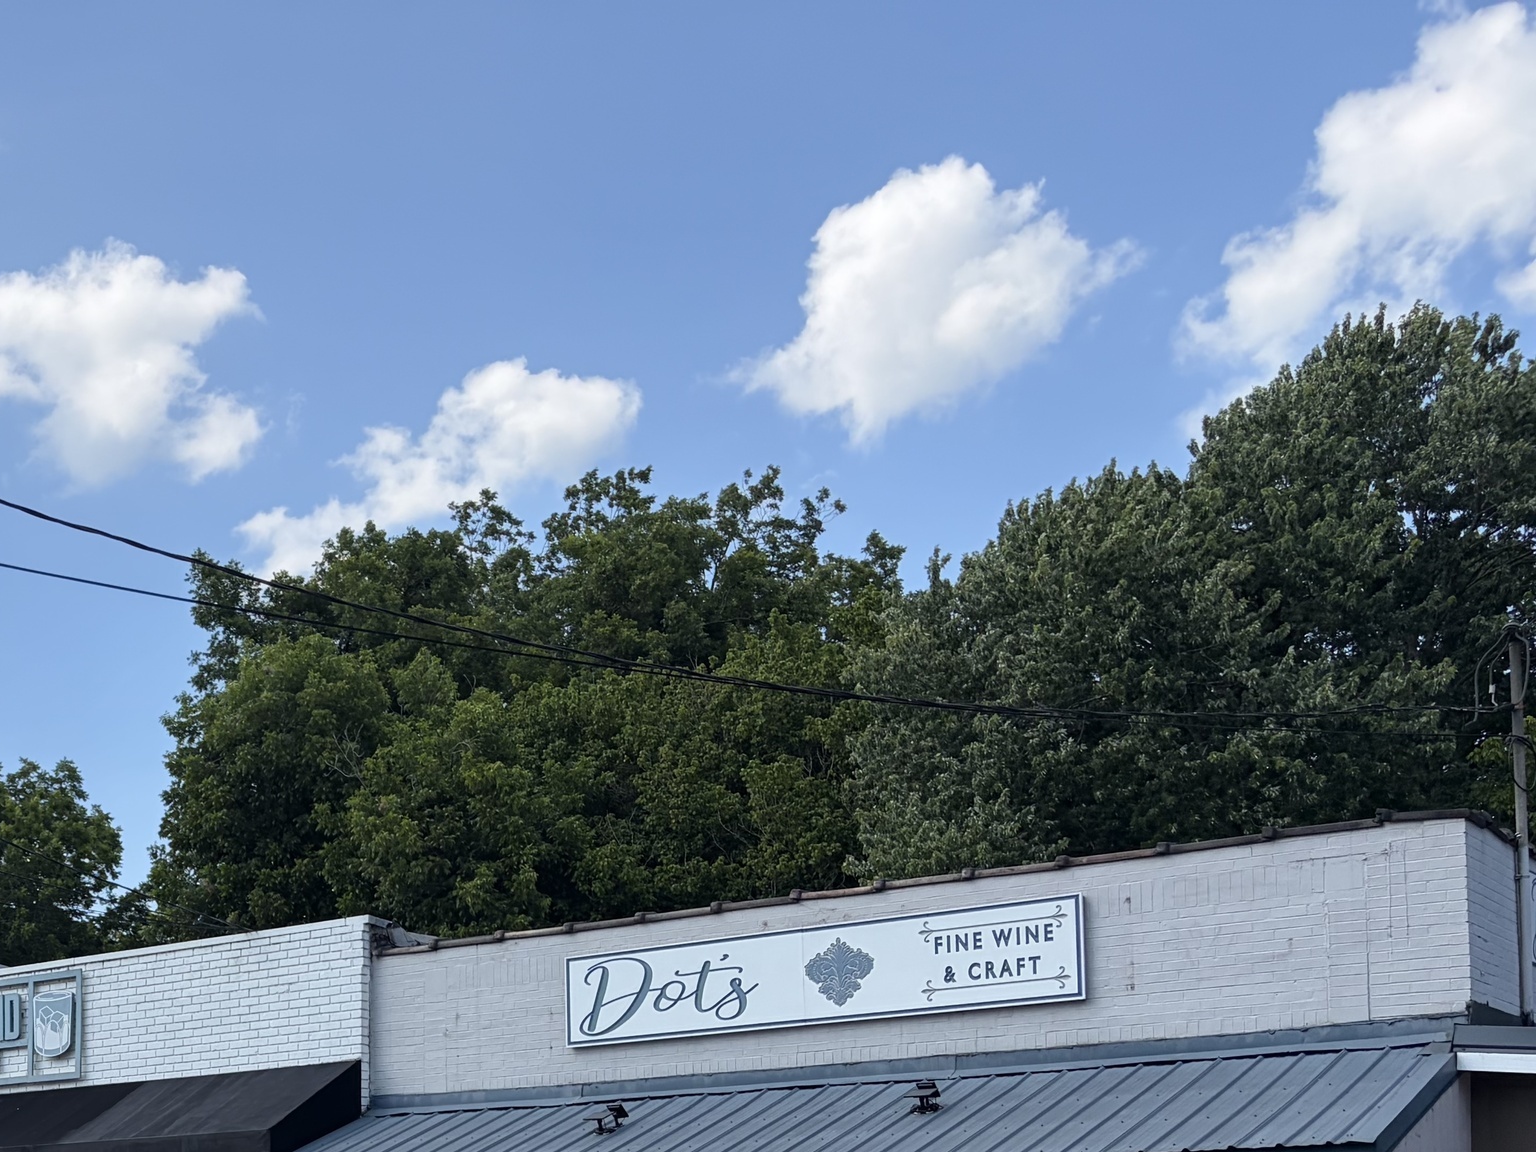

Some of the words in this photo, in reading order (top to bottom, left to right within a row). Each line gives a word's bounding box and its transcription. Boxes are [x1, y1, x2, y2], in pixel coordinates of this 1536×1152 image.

[933, 931, 982, 955] FINE
[992, 924, 1055, 948] WINE
[944, 966, 957, 983] &
[968, 955, 1042, 981] CRAFT
[579, 954, 759, 1036] Dot's
